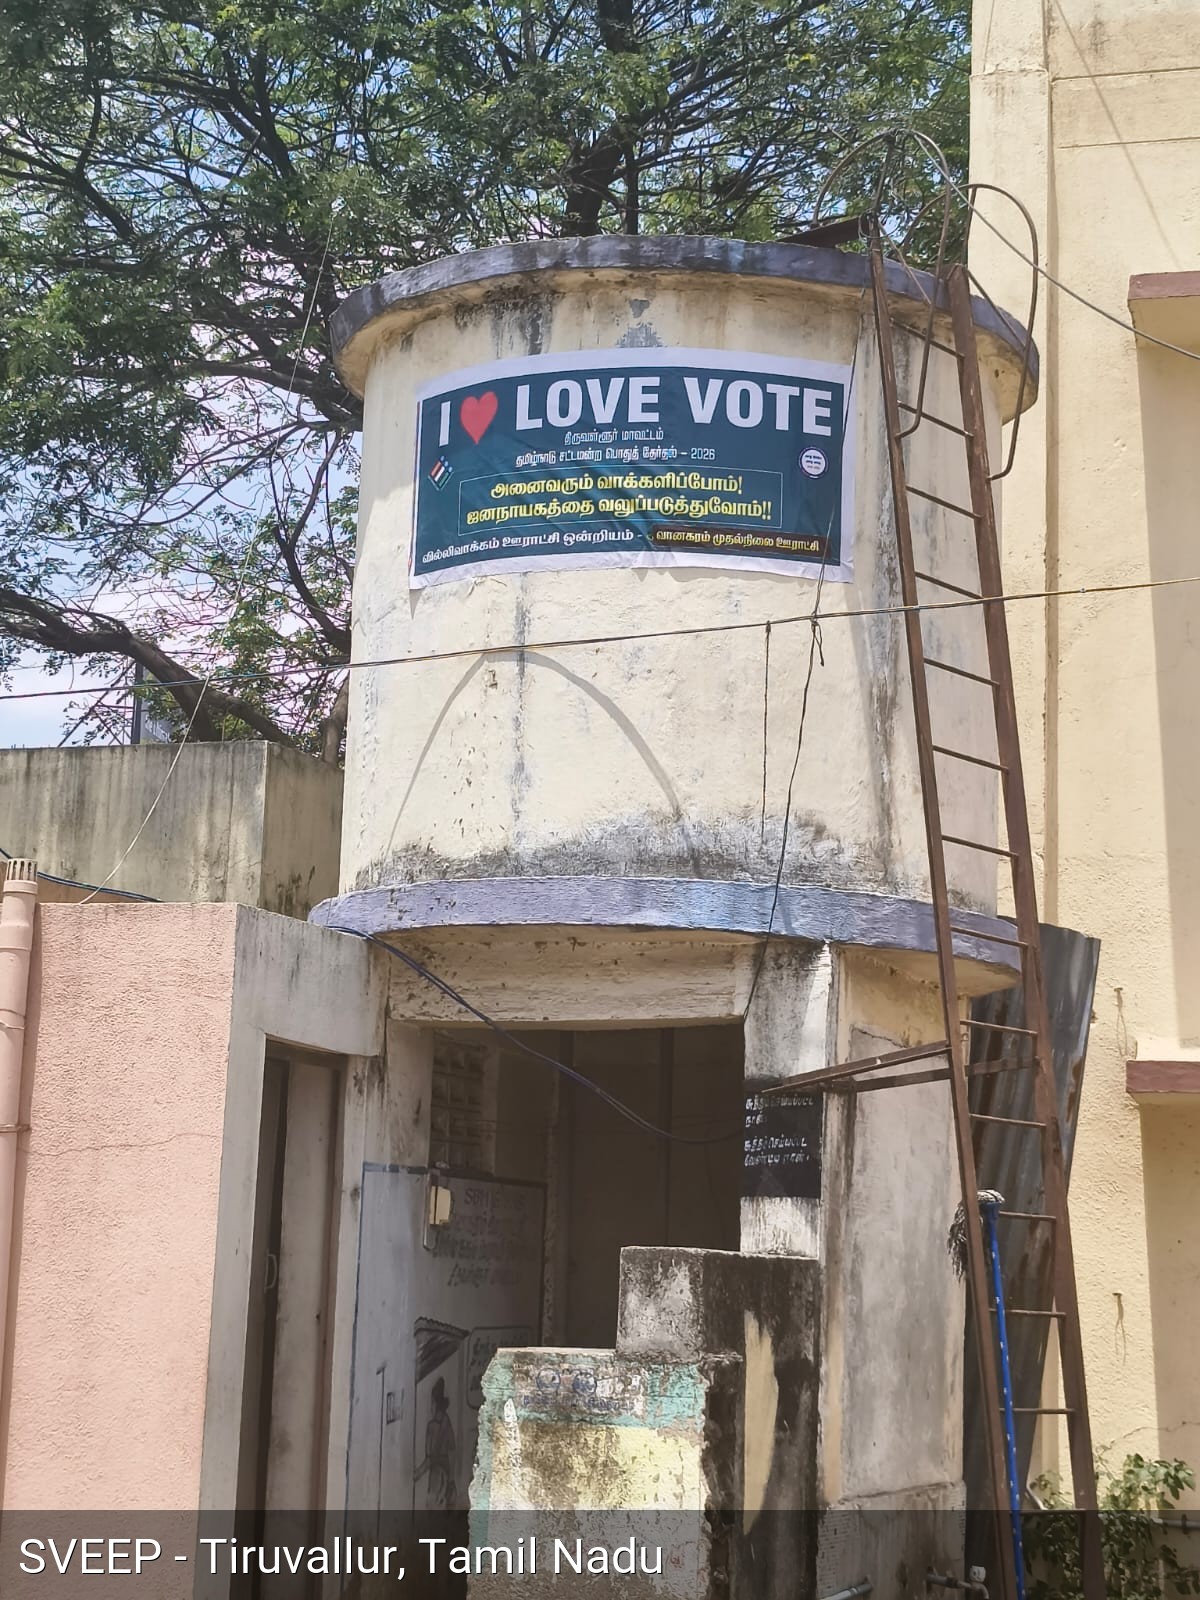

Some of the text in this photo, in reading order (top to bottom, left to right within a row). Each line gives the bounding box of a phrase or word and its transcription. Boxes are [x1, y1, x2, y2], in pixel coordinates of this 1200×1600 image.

[439, 377, 832, 447] I LOVE VOTE
[564, 427, 664, 445] திருவள்ளூர் மாவட்டம்
[515, 450, 556, 468] தமிழ்நாடு
[558, 447, 602, 463] சட்டமன்ற
[605, 445, 639, 463] பொதுத்
[642, 445, 678, 461] தேர்தல்
[690, 447, 715, 461] 2026
[490, 472, 743, 499] அனைவரும் வாக்களிப்போம்!
[466, 494, 772, 525] ஜனநாயகத்தை வலுப்படுத்துவோம்!!
[422, 536, 499, 563] வில்லிவாக்கம்
[502, 532, 560, 548] ஊராட்சி
[563, 529, 634, 546] ஒன்றியம்
[656, 530, 711, 544] வானகரம்
[712, 533, 774, 548] முதல்நிலை
[776, 537, 819, 551] ஊராட்சி
